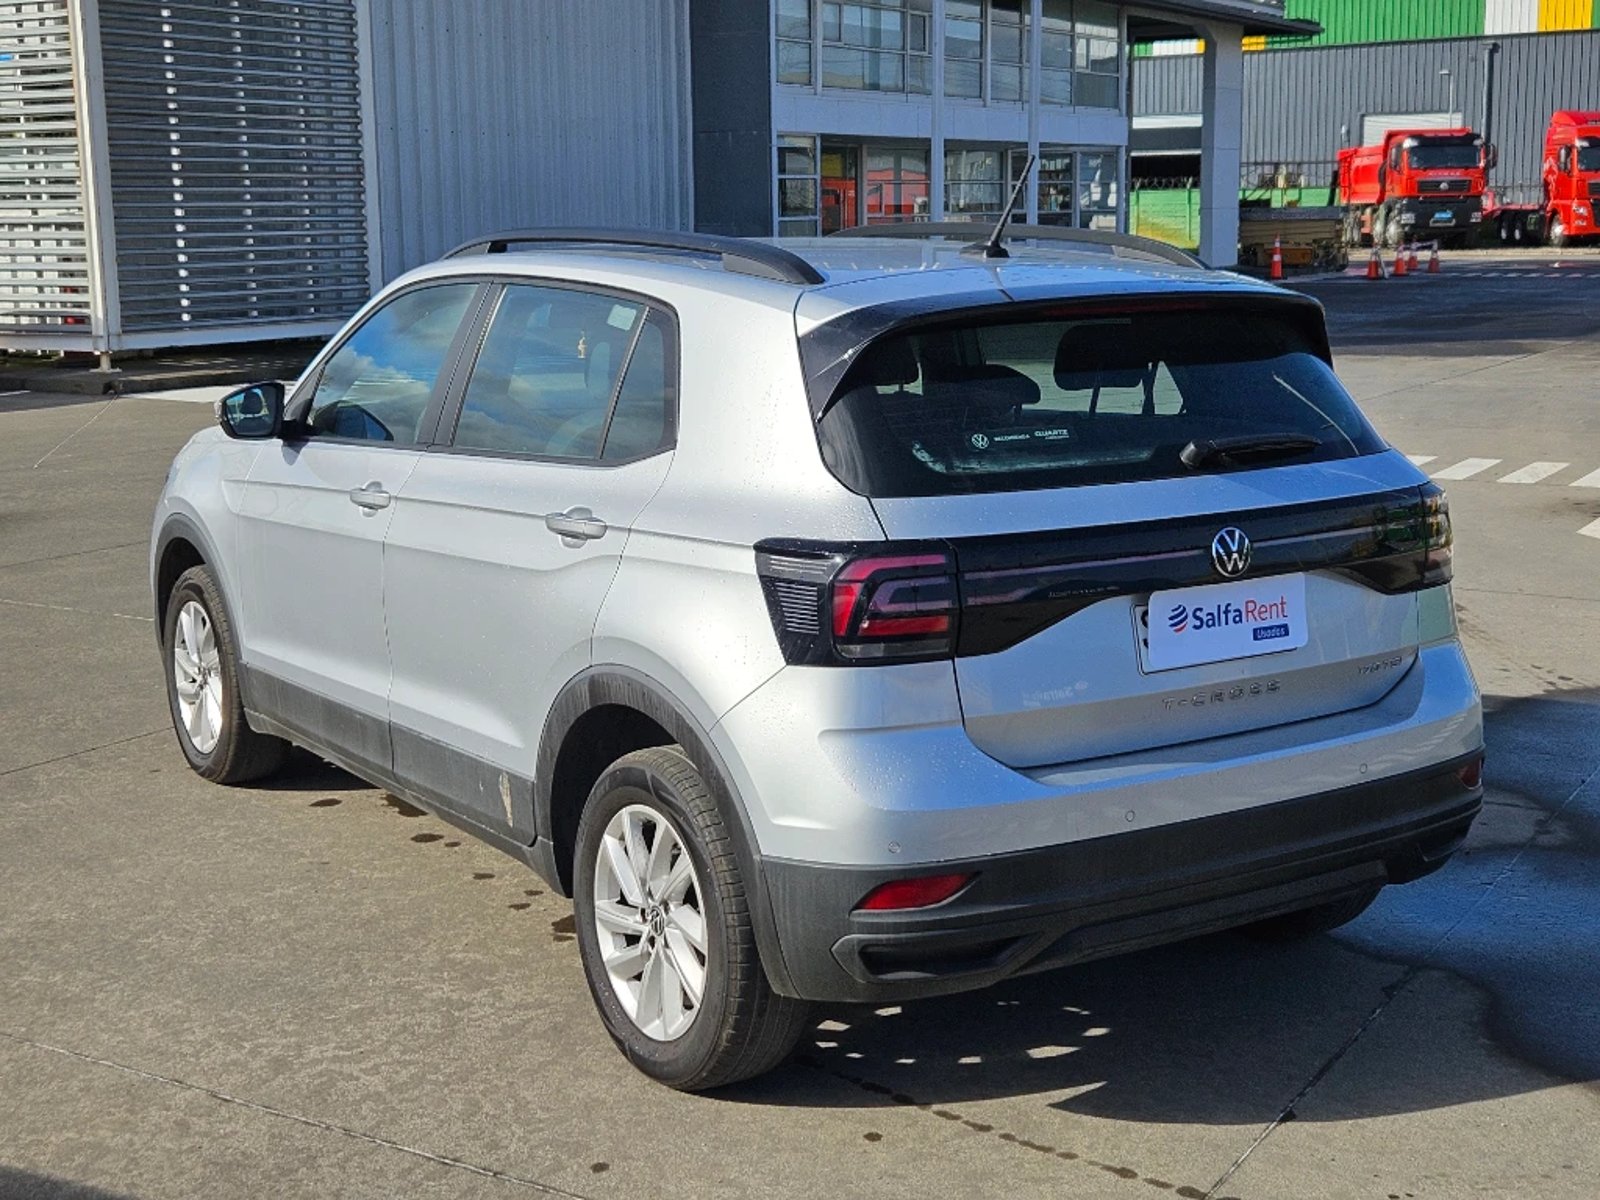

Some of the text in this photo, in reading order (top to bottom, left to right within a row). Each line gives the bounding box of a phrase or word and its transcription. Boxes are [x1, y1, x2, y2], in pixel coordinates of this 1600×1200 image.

[1191, 596, 1288, 630] SalfaRent
[1257, 627, 1286, 639] Usados
[1162, 679, 1281, 711] T-CROSS
